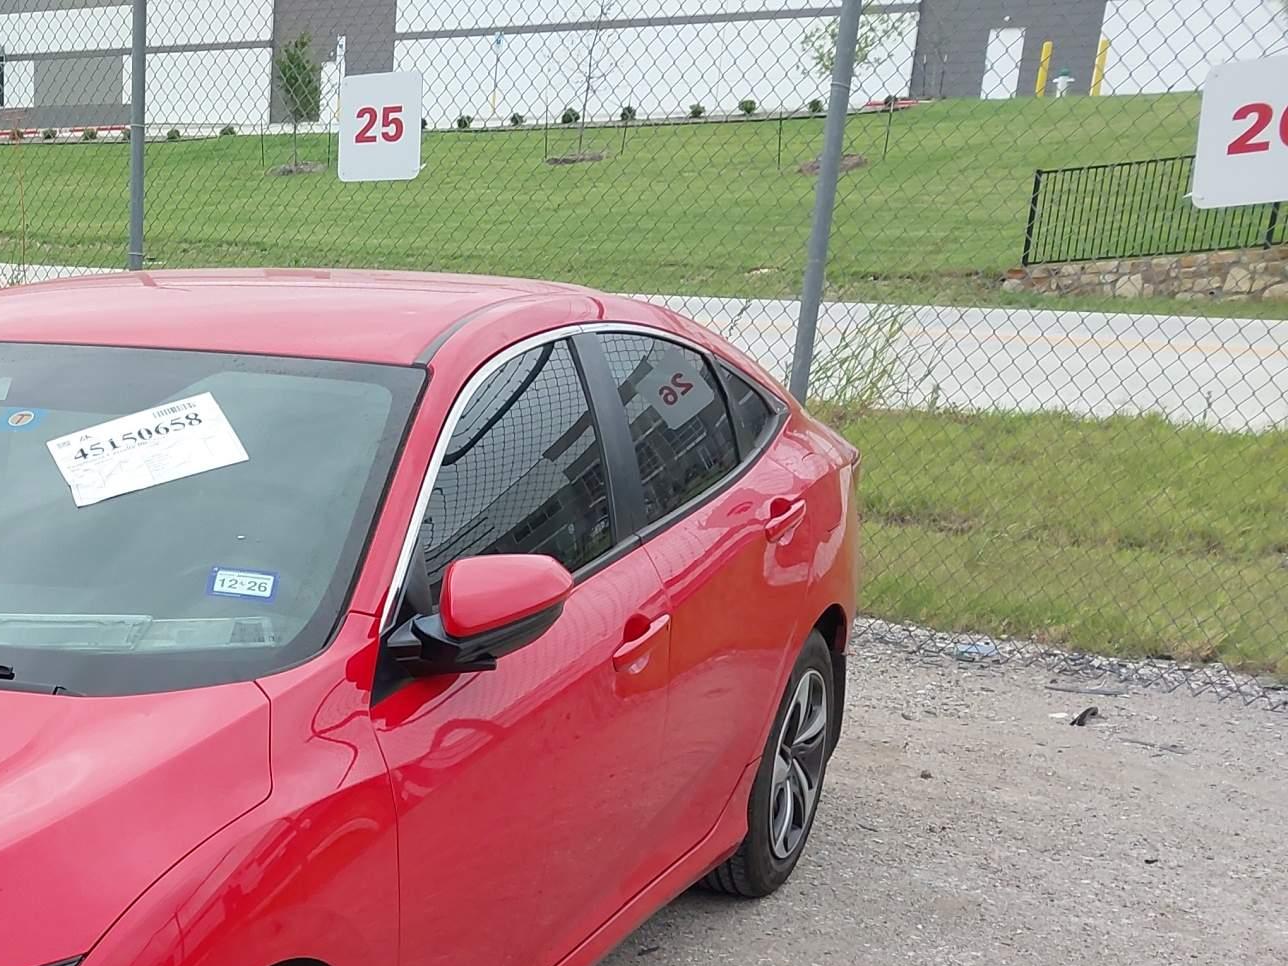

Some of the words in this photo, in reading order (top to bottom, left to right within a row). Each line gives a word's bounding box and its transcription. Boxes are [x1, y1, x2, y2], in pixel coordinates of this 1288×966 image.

[355, 105, 404, 144] 25
[1227, 102, 1288, 155] 2
[73, 412, 203, 460] 45150658
